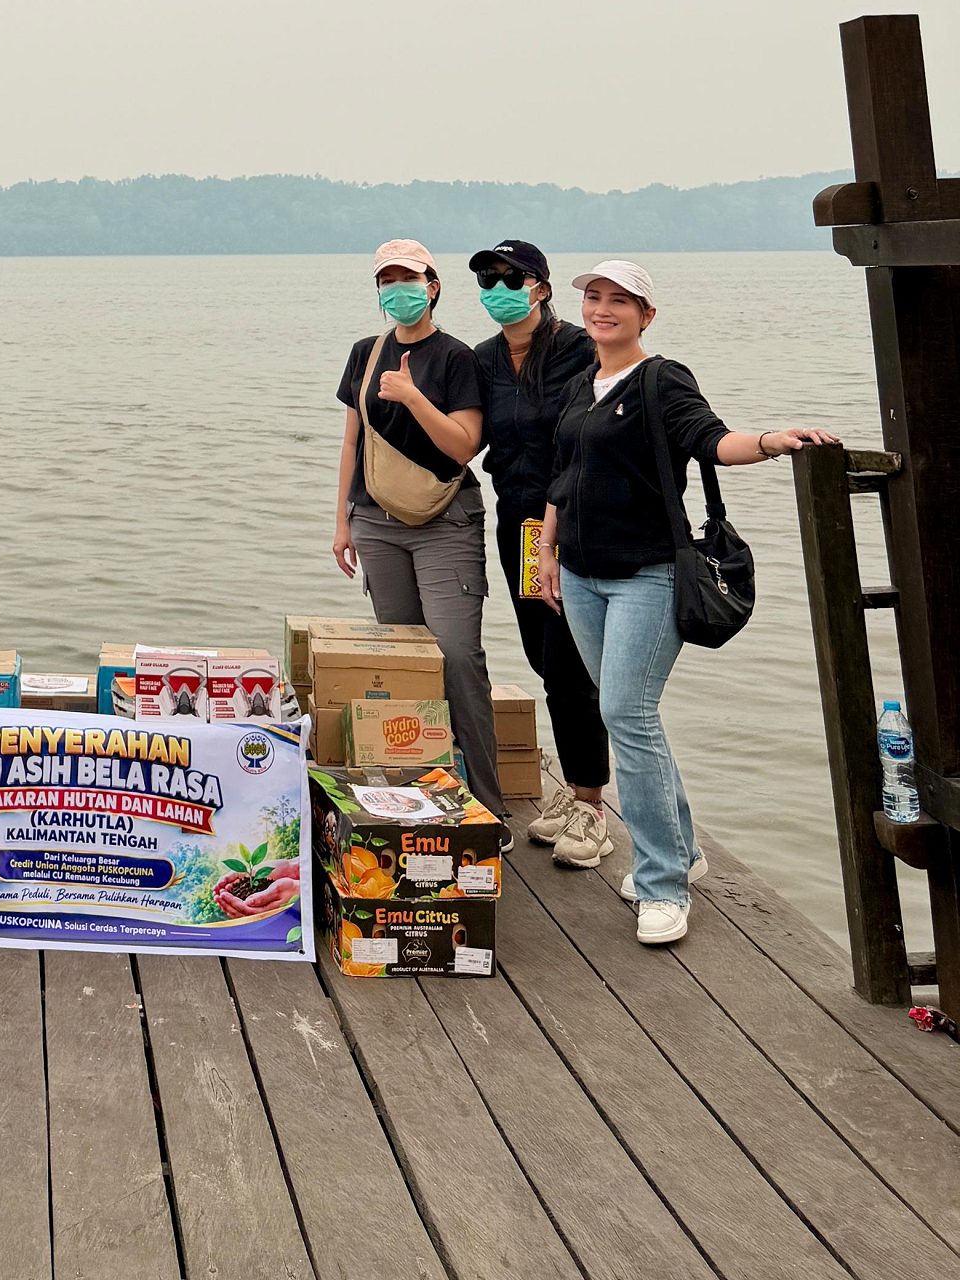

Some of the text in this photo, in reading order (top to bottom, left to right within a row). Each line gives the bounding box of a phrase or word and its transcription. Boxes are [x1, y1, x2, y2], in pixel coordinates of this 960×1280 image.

[383, 716, 419, 735] Hydro
[886, 741, 901, 751] Pure
[6, 755, 72, 786] ASIH
[77, 756, 146, 792] BELA
[150, 763, 222, 807] RASA
[63, 791, 117, 810] HUTAN
[121, 796, 153, 815] DAN
[156, 801, 204, 825] LAHAN
[30, 809, 134, 833] (KARHUTLA)
[6, 827, 158, 850] KALIMANTAN TENGAH
[401, 832, 450, 852] Emu
[10, 859, 154, 877] Credit Union Anggota PUSKOPCUINA
[44, 852, 120, 865] Dari Keluarga Besar
[23, 869, 140, 886] melalui CU Remaung Kecubung
[21, 887, 52, 901] Peduli,
[54, 888, 95, 902] Bersama
[97, 890, 139, 904] Pulihkan
[140, 894, 182, 911] Harapan
[375, 907, 460, 925] Emu Citrus
[64, 921, 88, 931] Solusi
[89, 923, 118, 933] Cerdas
[120, 925, 167, 937] Terpercaya
